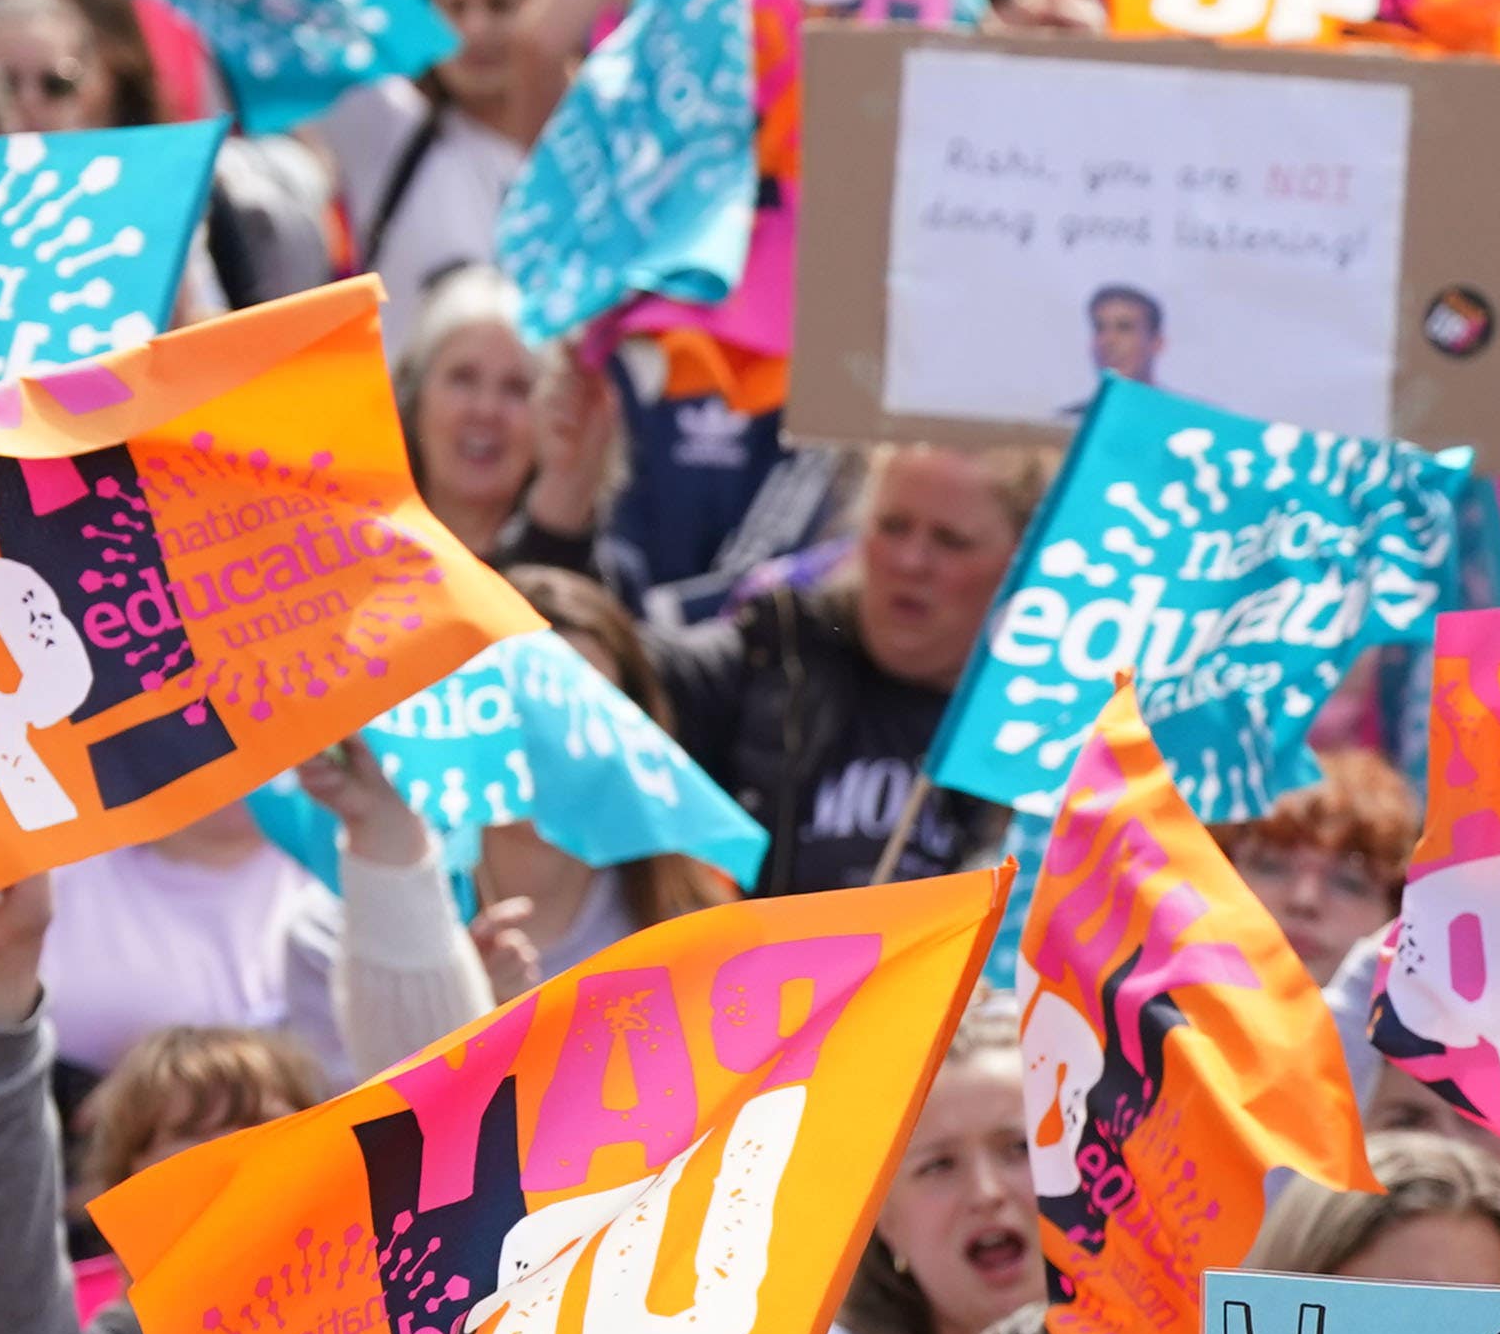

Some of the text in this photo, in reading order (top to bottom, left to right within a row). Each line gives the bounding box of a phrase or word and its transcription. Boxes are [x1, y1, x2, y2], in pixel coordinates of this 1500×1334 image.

[1081, 157, 1153, 195] you
[1174, 161, 1242, 195] are
[1263, 162, 1355, 205] NOT
[218, 581, 351, 650] union
